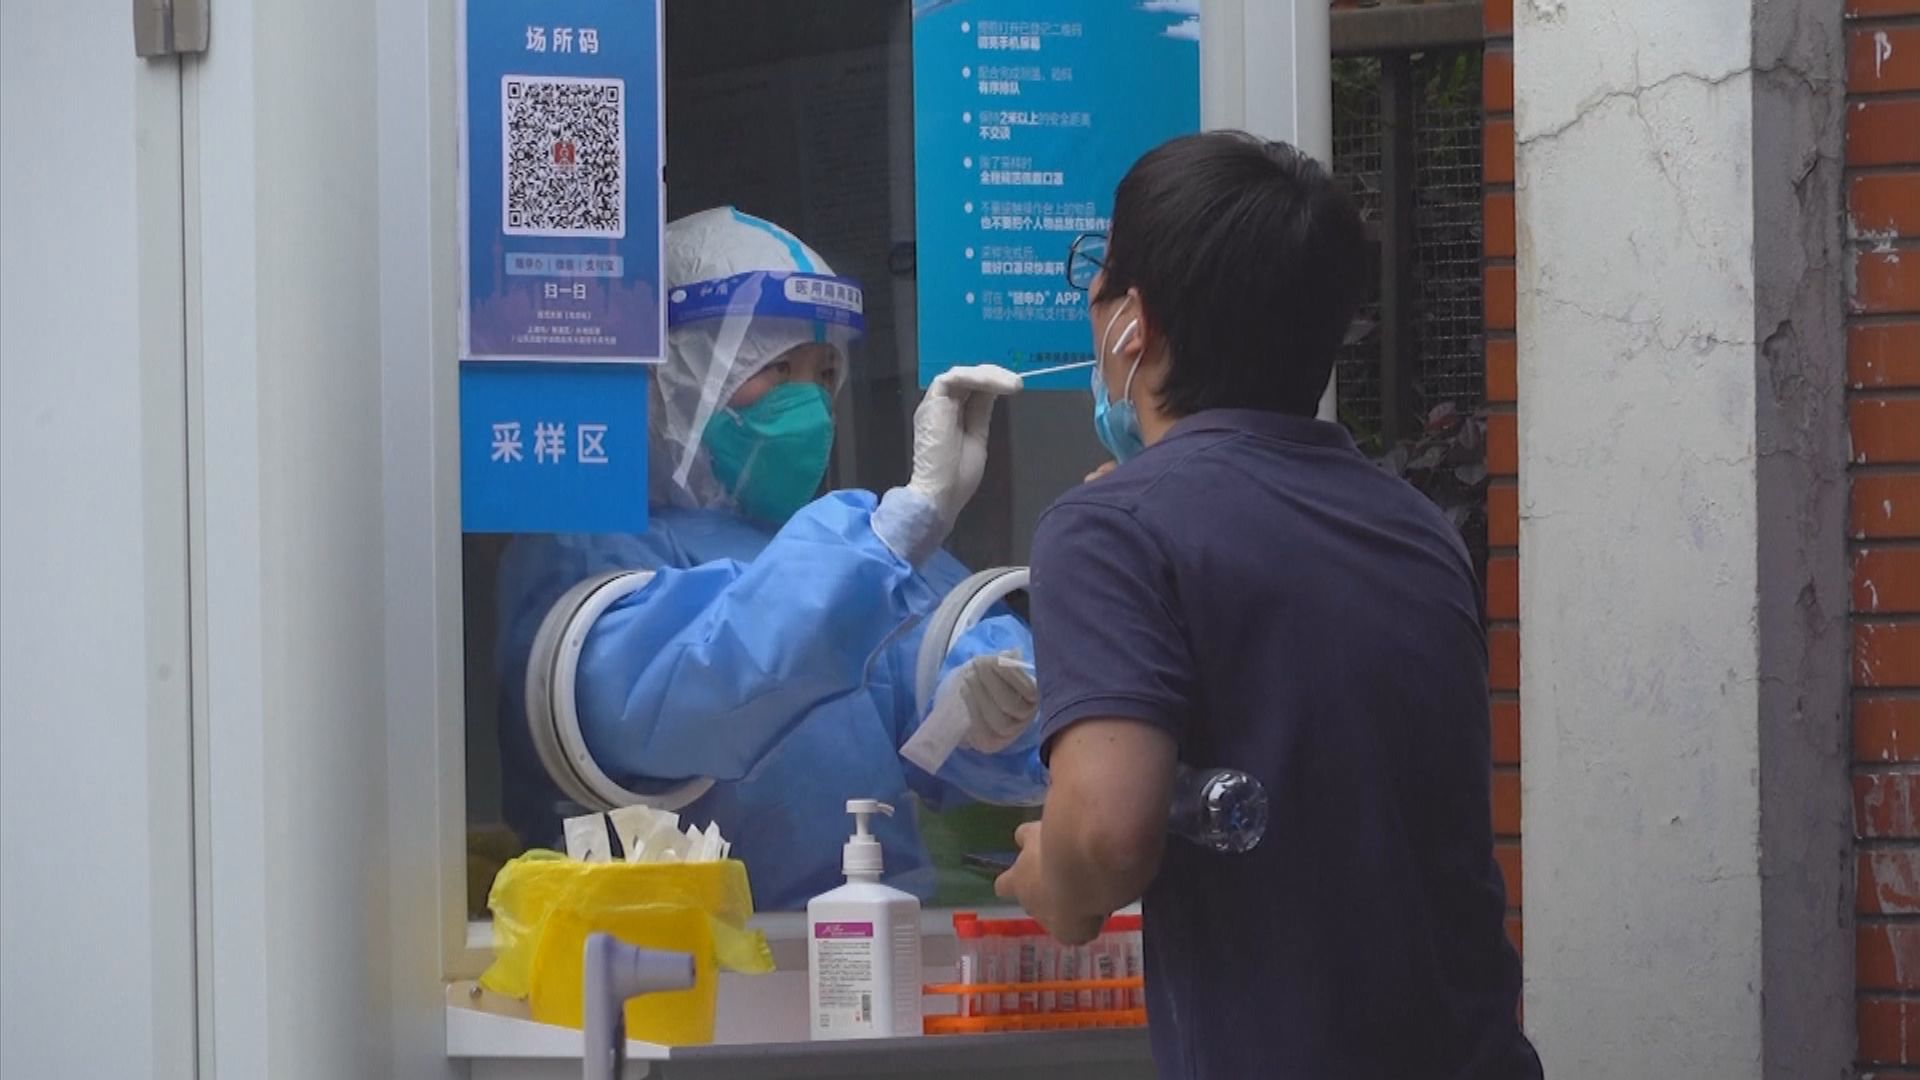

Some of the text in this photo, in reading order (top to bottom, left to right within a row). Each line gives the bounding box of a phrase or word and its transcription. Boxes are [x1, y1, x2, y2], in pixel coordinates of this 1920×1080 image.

[525, 26, 599, 53] 场所码
[979, 125, 1010, 140] 不交谈
[544, 283, 586, 300] 扫一扫
[491, 422, 609, 464] 采样区
